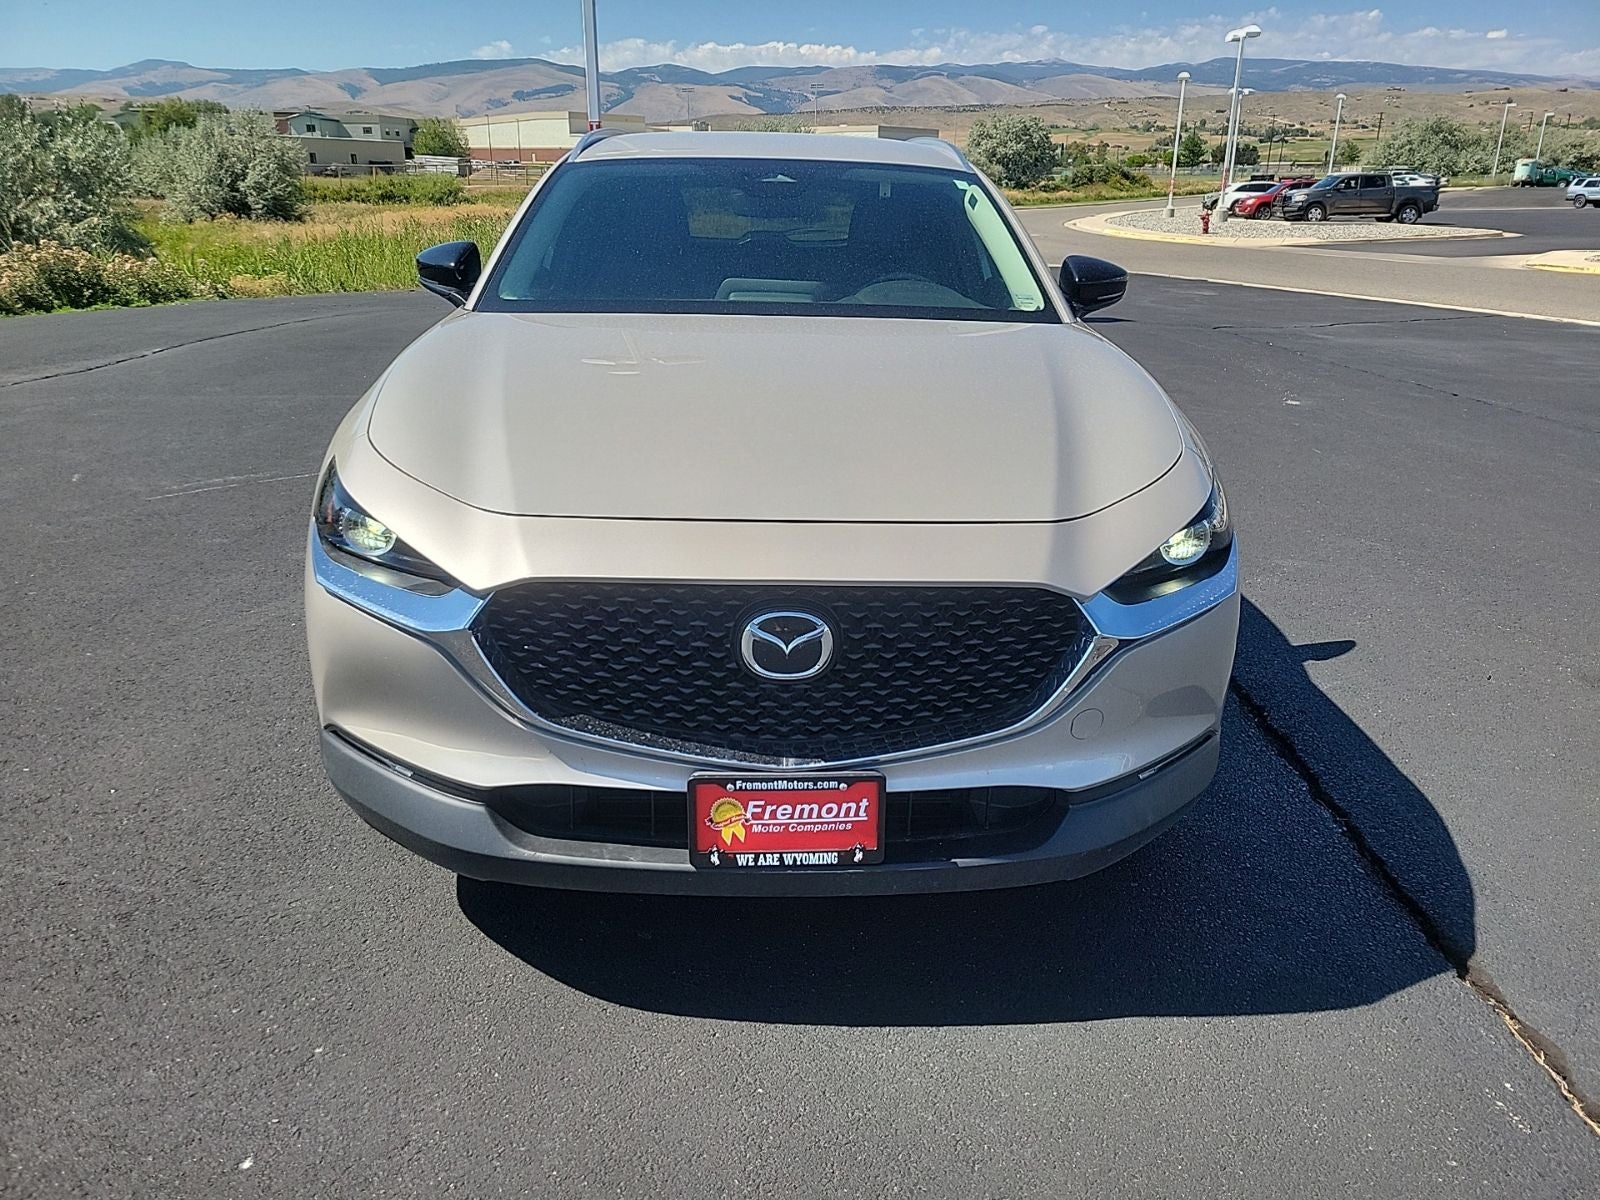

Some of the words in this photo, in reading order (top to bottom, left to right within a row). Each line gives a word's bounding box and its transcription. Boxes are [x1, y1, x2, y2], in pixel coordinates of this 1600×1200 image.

[736, 780, 838, 790] FremontMotors.com
[746, 798, 869, 820] Fremont
[752, 823, 785, 833] Motor
[788, 822, 852, 834] Companies
[736, 854, 755, 866] WE
[757, 853, 780, 866] ARE
[782, 852, 838, 865] WYOMING
